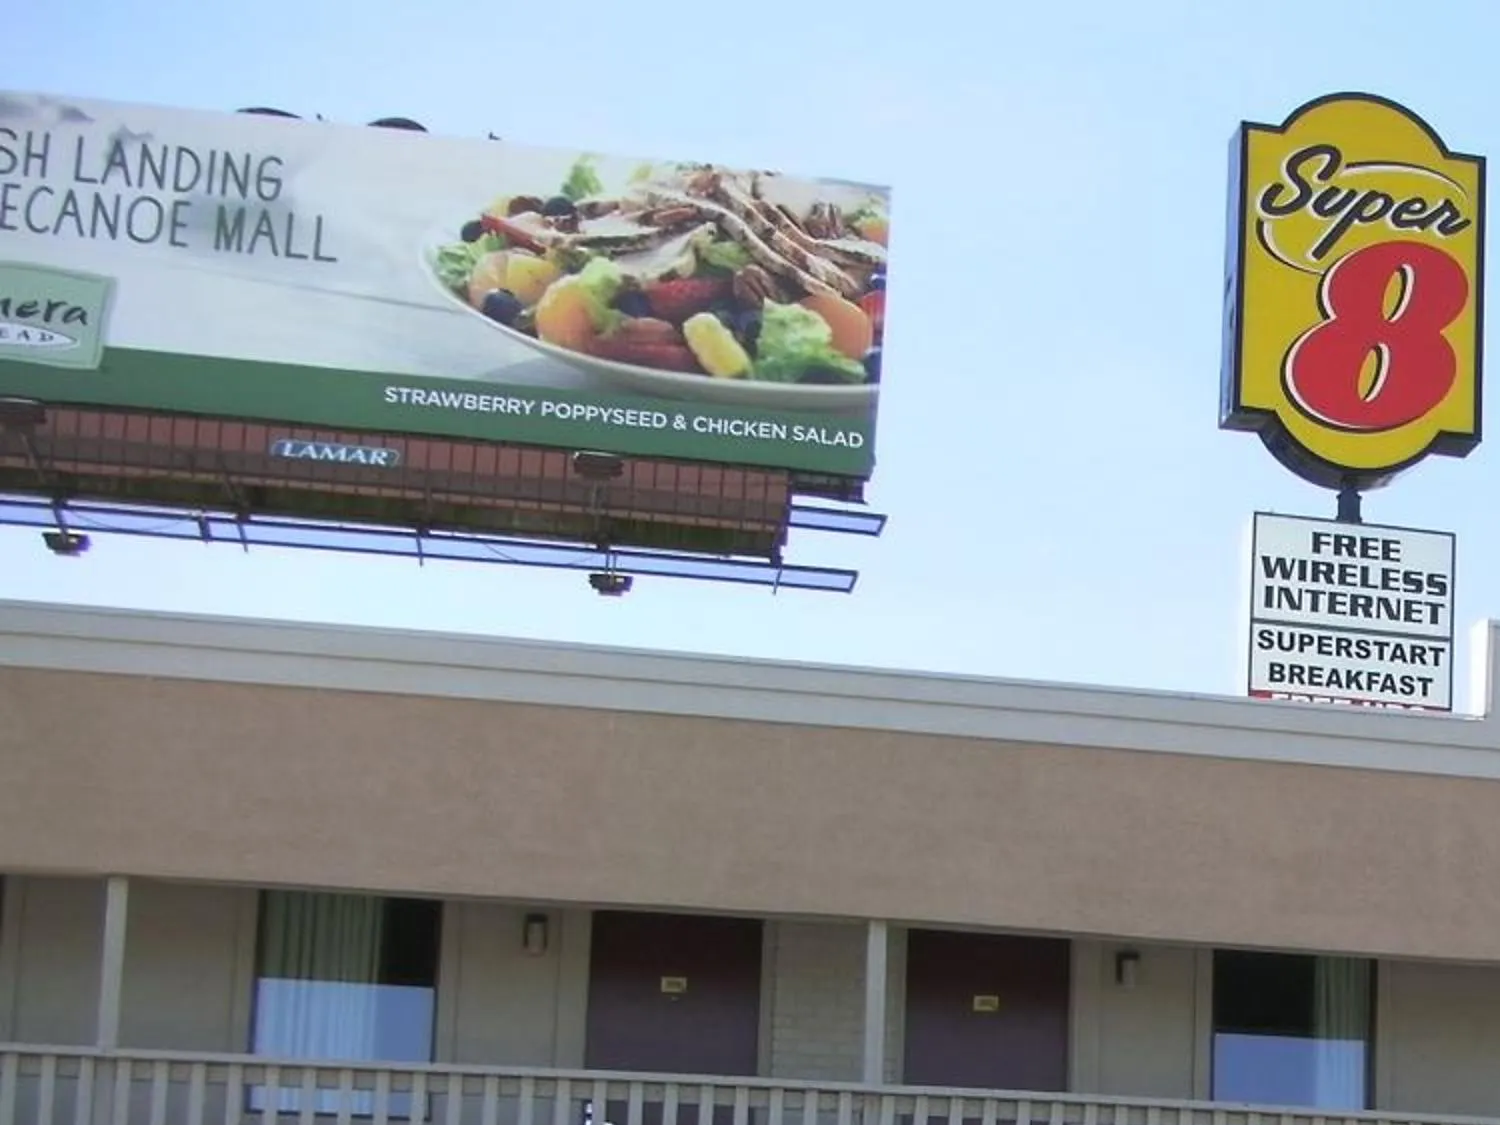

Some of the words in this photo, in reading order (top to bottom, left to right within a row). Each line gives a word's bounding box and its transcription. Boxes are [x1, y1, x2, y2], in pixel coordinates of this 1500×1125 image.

[0, 127, 51, 178] SH
[74, 134, 284, 201] LANDING
[0, 183, 192, 247] ECANOE
[213, 204, 338, 262] MALL
[1259, 143, 1472, 262] Super
[1280, 239, 1470, 435] 8
[384, 386, 535, 415] STRAWBERRY
[540, 402, 667, 429] POPPYSEED
[672, 414, 688, 431] &
[692, 416, 787, 440] CHICKEN
[792, 425, 864, 449] SALAD
[282, 442, 388, 466] LAMAR
[1311, 531, 1401, 562] FREE
[1261, 555, 1448, 597] WIRELESS
[1263, 585, 1446, 625] INTERNET
[1257, 629, 1446, 667] SUPERSTART
[1268, 662, 1434, 697] BREAKFAST
